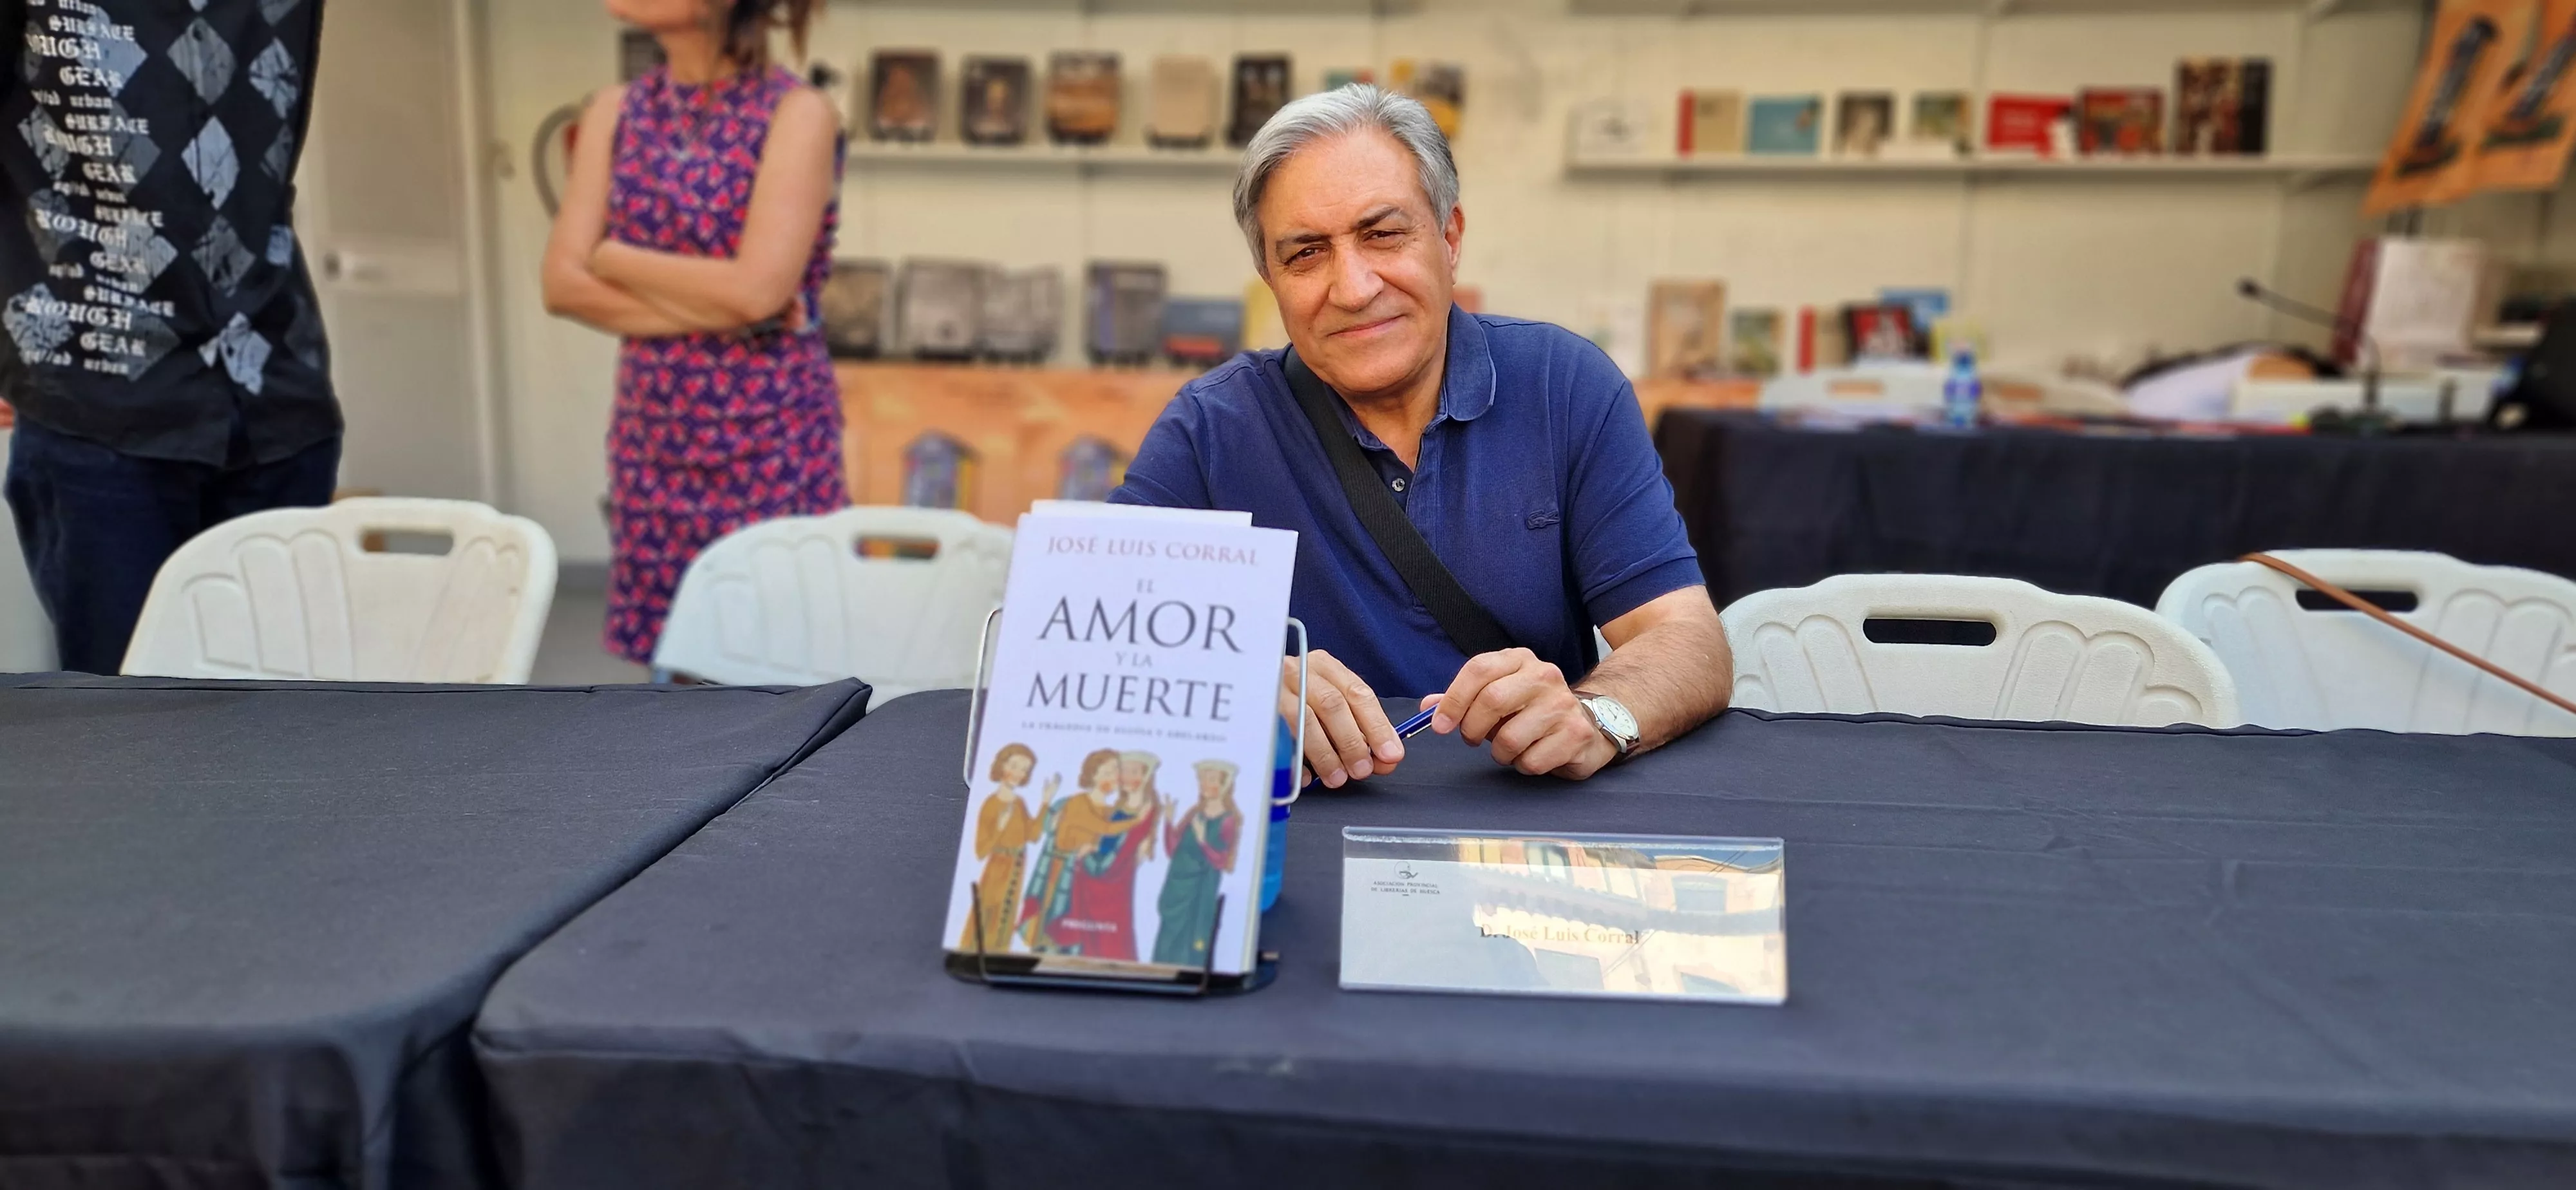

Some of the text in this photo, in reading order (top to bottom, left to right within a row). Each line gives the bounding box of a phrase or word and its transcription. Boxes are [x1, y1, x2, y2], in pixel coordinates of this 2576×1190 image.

[1046, 535, 1258, 566] JOSÉ LUIS CORRAL
[1137, 579, 1155, 594] EL
[1036, 596, 1244, 654] AMOR
[1115, 652, 1153, 667] Y LA
[1026, 672, 1234, 722] MUERTE
[1503, 925, 1538, 940] José
[1544, 926, 1578, 942] Luis
[1584, 928, 1639, 945] Corral
